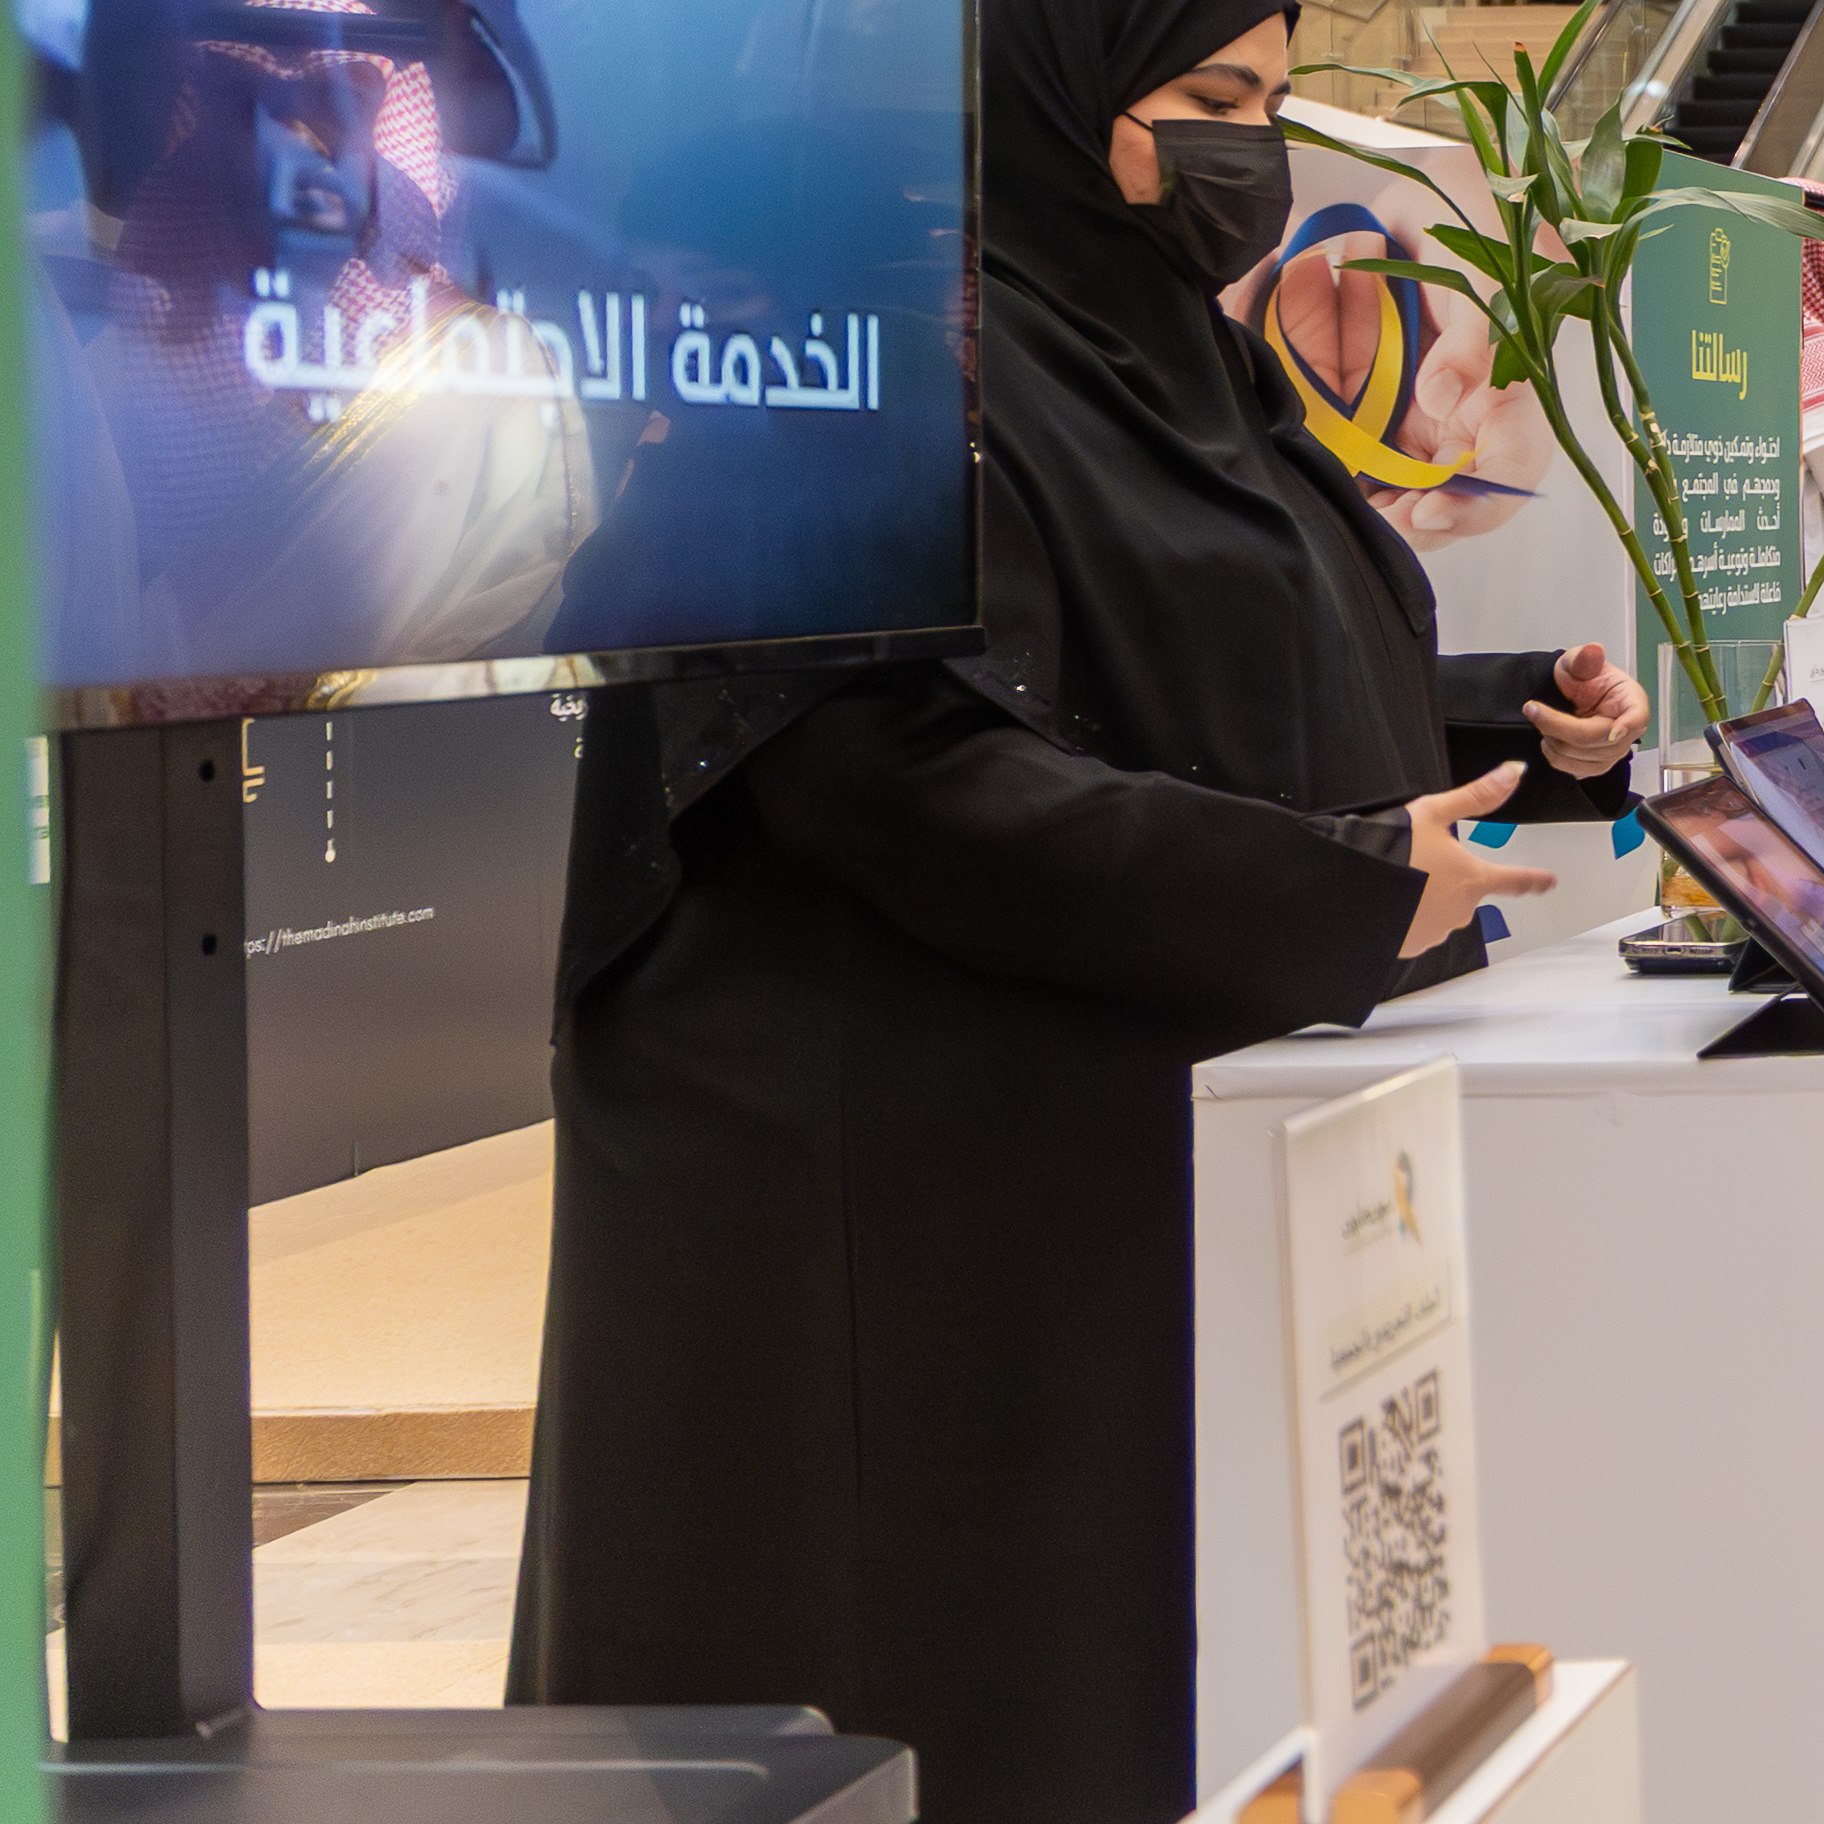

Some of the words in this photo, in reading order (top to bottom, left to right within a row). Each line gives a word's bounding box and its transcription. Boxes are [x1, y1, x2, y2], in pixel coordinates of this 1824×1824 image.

[243, 266, 646, 428] الاجتماعية
[672, 301, 879, 411] الخدمة
[1691, 329, 1747, 400] رسالتنا
[1672, 433, 1704, 463] متلازمة
[1704, 435, 1723, 464] ذوي
[1723, 435, 1754, 464] وتمكين
[1754, 435, 1781, 464] احتواء
[1682, 472, 1719, 502] المجتمع
[1723, 473, 1738, 500] في
[1742, 477, 1781, 501] ودمجهم
[1700, 509, 1746, 539] الممارسات
[1757, 502, 1781, 531] أحدث
[1719, 547, 1749, 576] وتوعية
[1749, 545, 1781, 568] متكاملة
[1761, 581, 1781, 603] فاعلة
[244, 907, 434, 959] ps://themadinahinstitute.com
